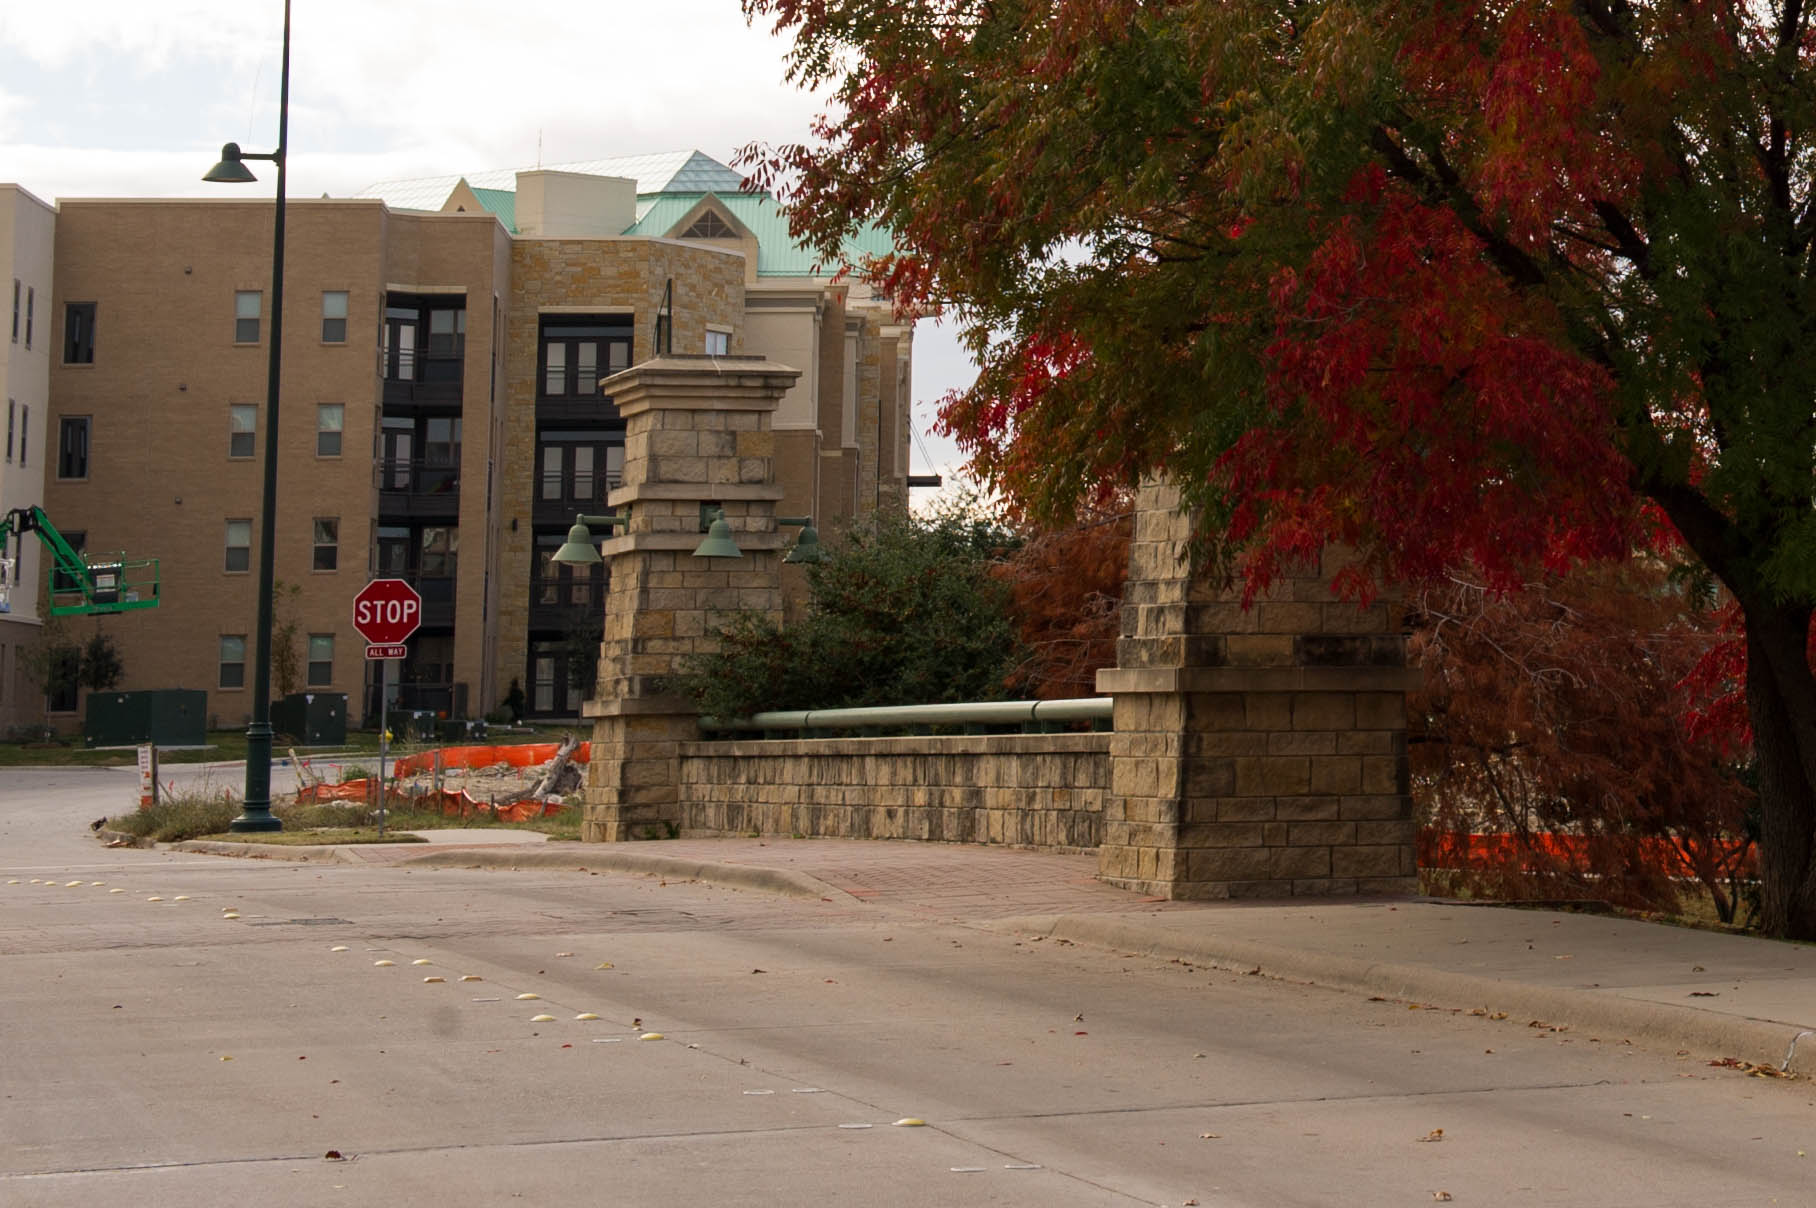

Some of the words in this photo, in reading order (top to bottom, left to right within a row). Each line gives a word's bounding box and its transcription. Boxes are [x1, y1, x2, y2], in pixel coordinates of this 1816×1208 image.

[357, 599, 417, 624] STOP
[369, 648, 384, 657] ALL
[388, 647, 404, 656] WAY
